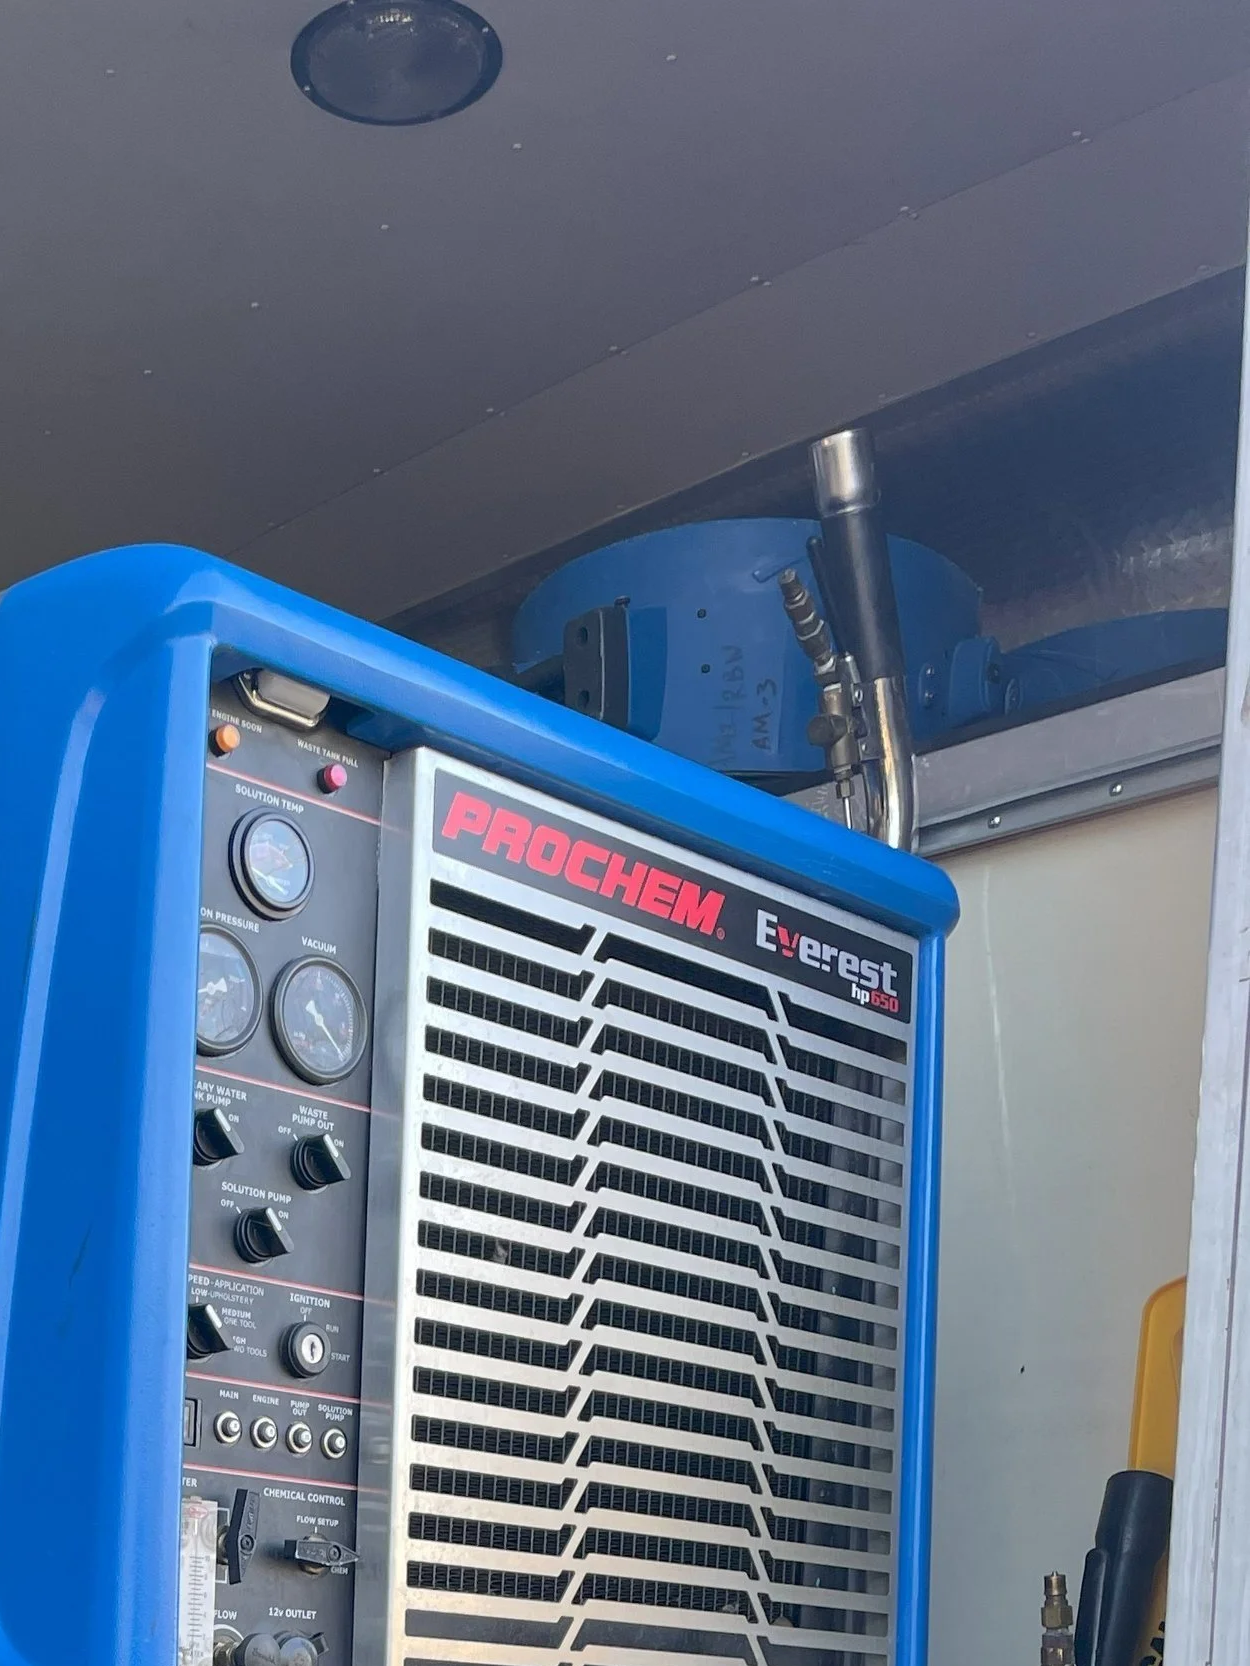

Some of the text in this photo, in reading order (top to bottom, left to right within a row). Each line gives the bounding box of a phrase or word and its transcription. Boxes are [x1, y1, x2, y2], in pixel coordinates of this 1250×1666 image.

[211, 708, 263, 734] ENGINE SOON
[297, 739, 359, 768] WASTE TANK FULL
[235, 783, 305, 814] SOLUTION TEMP
[441, 790, 726, 937] PROCHEM
[215, 910, 260, 934] PRESSURE
[301, 936, 337, 954] VACUUM
[755, 908, 899, 998] Everest
[206, 1092, 231, 1107] PUMP
[216, 1085, 247, 1102] WATER
[228, 1113, 239, 1123] ON
[299, 1105, 328, 1120] WASTE
[292, 1113, 335, 1131] PUMP OUT
[278, 1125, 292, 1135] OFF
[334, 1138, 344, 1148] ON
[221, 1181, 292, 1205] SOLUTION PUMP
[220, 1198, 235, 1208] OFF
[278, 1210, 289, 1219] ON
[289, 1293, 331, 1309] IGNITION
[221, 1306, 251, 1320] MEDIUM
[300, 1306, 312, 1316] OFF
[223, 1316, 256, 1330] ONE TOOL
[326, 1324, 339, 1334] RUN
[246, 1347, 267, 1358] TOOLS
[331, 1352, 350, 1363] START
[219, 1389, 239, 1400] MAIN
[252, 1394, 280, 1406] ENGINE
[290, 1399, 310, 1410] PUMP
[318, 1404, 353, 1416] SOLUTION
[292, 1407, 307, 1417] OUT
[325, 1412, 344, 1422] PUMP
[263, 1487, 346, 1506] CHEMICAL CONTROL
[296, 1515, 339, 1528] FLOW SETUP
[330, 1566, 348, 1575] CHEM
[268, 1606, 317, 1620] 12v OUTLET
